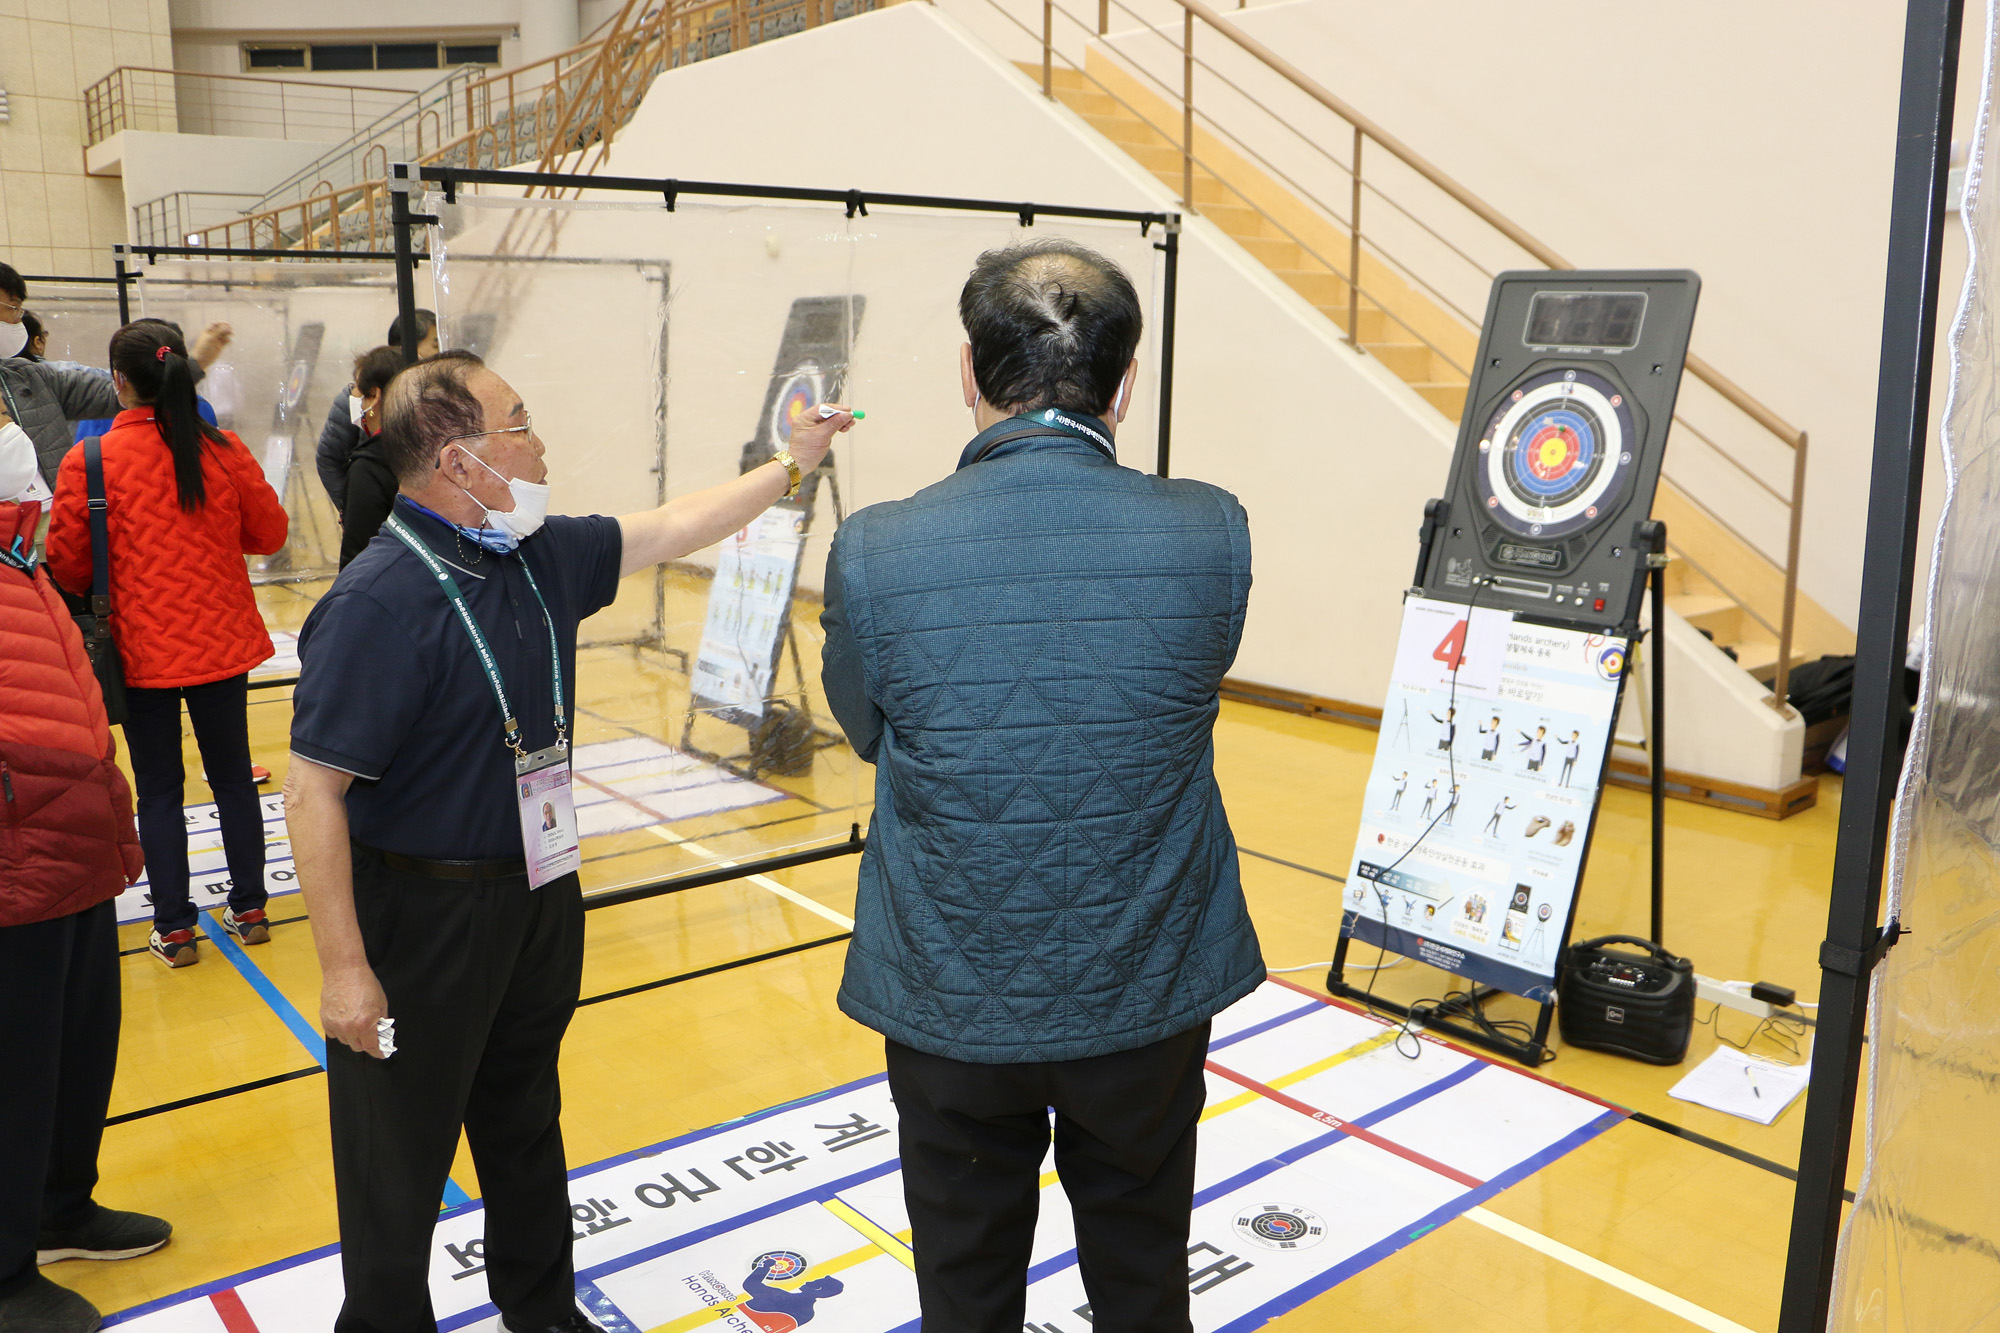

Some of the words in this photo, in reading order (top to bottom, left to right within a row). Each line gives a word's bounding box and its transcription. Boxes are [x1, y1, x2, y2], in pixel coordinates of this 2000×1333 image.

[1432, 619, 1469, 671] 4
[1311, 1110, 1344, 1129] 0.5m
[681, 1275, 720, 1307] Hands
